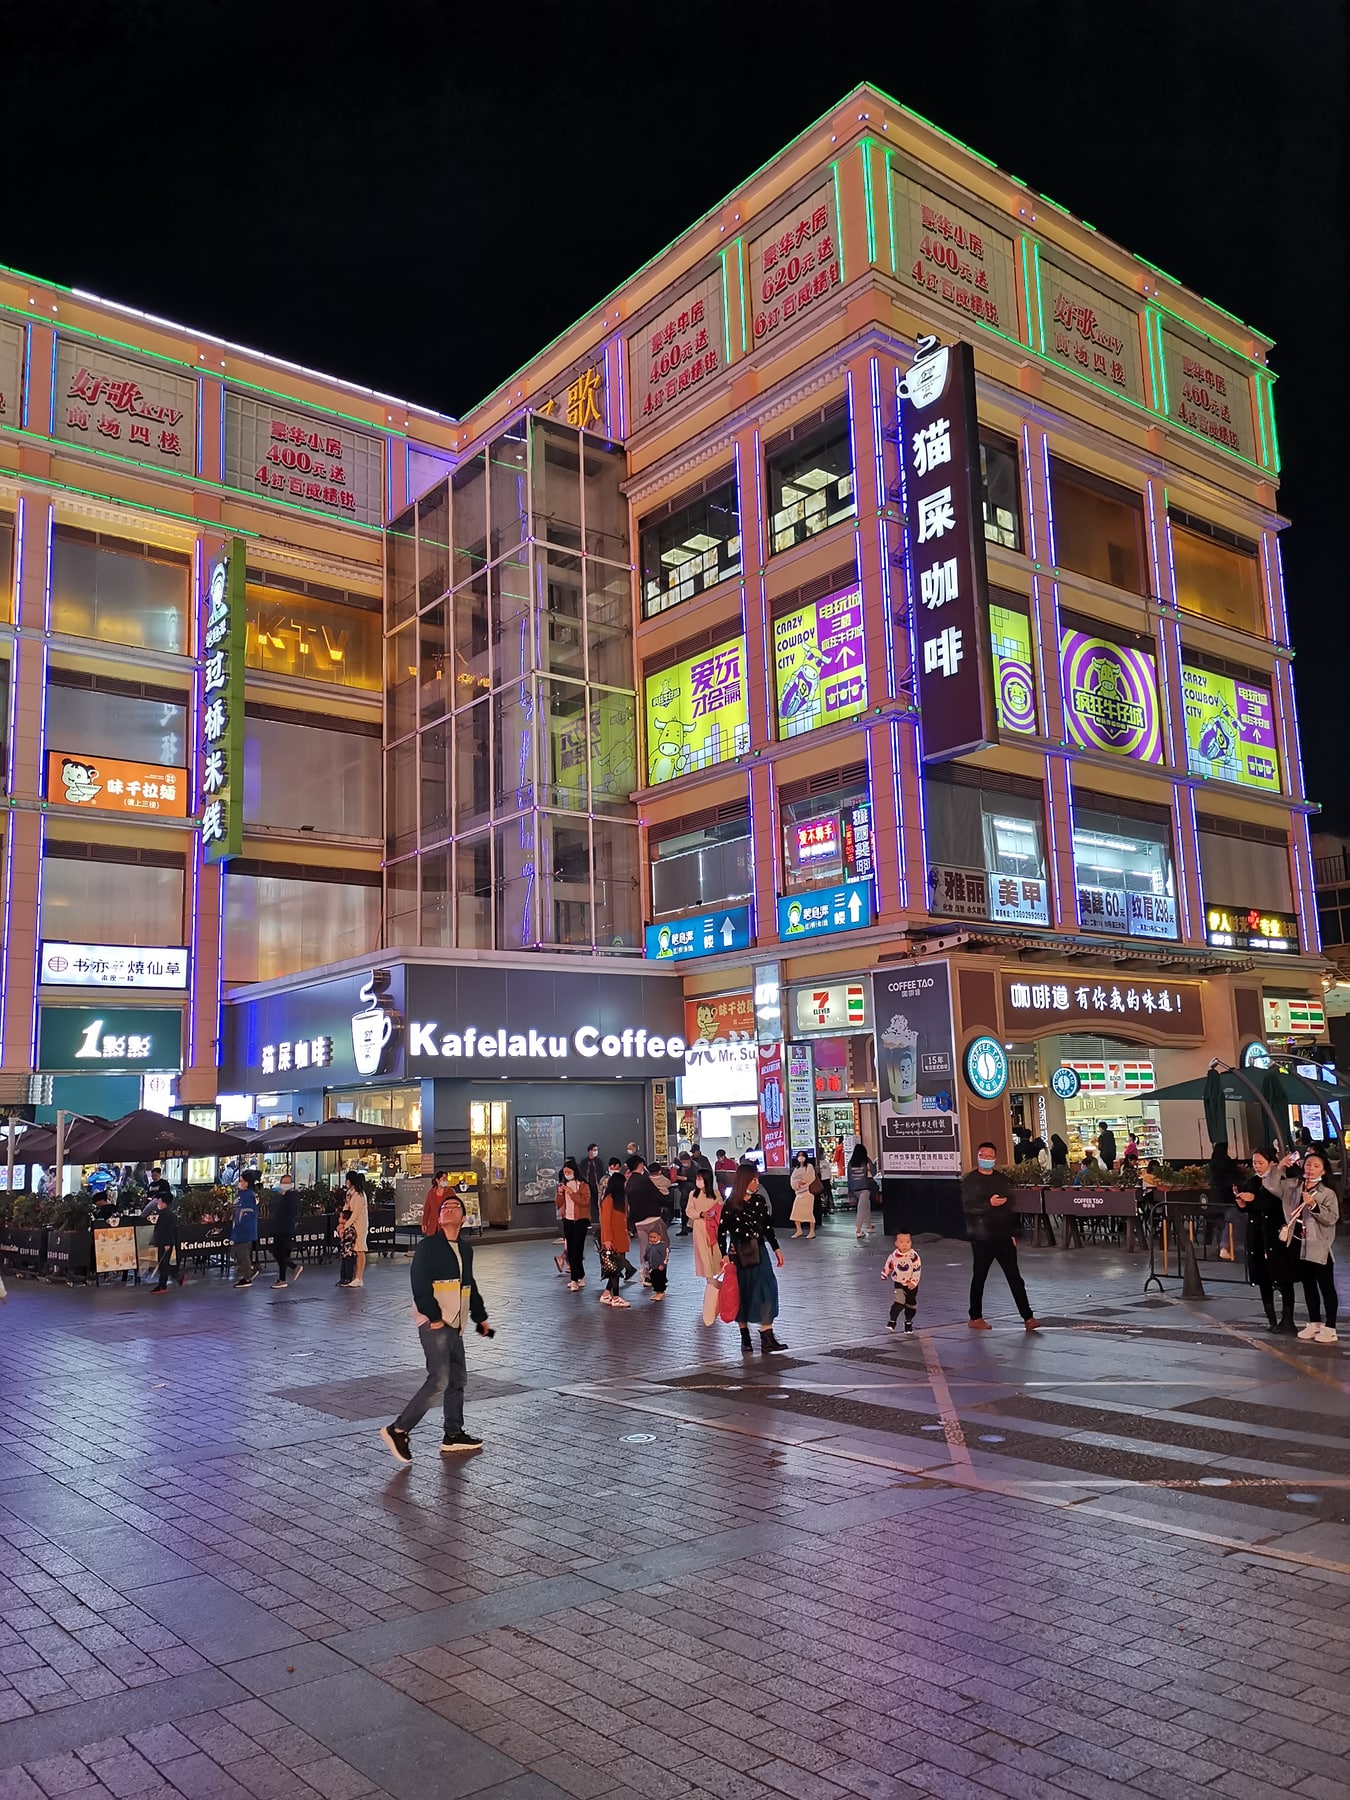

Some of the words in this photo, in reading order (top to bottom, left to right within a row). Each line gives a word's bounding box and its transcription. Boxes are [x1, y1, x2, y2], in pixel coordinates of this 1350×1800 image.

[763, 205, 827, 269] 豪华大房
[67, 405, 181, 452] 商场四楼
[270, 420, 342, 456] 豪华小房
[912, 417, 964, 677] 猫屎咖啡
[776, 615, 803, 635] CRAZY
[776, 627, 815, 652] COWBOY
[690, 646, 740, 697] 爱玩
[777, 653, 795, 670] CITY
[1183, 671, 1207, 688] CRAZY
[1075, 691, 1144, 728] 疯狂牛仔城
[1184, 688, 1219, 707] COWBOY
[1185, 705, 1202, 719] CITY
[202, 650, 226, 844] 过桥米线
[998, 878, 1041, 909] 美甲
[887, 981, 916, 992] COFFEE
[917, 978, 934, 988] TAO
[1010, 983, 1070, 1010] 咖啡道
[813, 992, 829, 1024] 7
[409, 1023, 567, 1057] Kafelaku
[574, 1025, 685, 1057] Coffee
[262, 1036, 328, 1075] 猫屎咖啡
[718, 1049, 737, 1062] Mr.
[972, 1042, 990, 1069] COFFEE
[1108, 1063, 1120, 1089] 7
[369, 1226, 395, 1234] Coffee
[180, 1239, 222, 1250] Kafelaku
